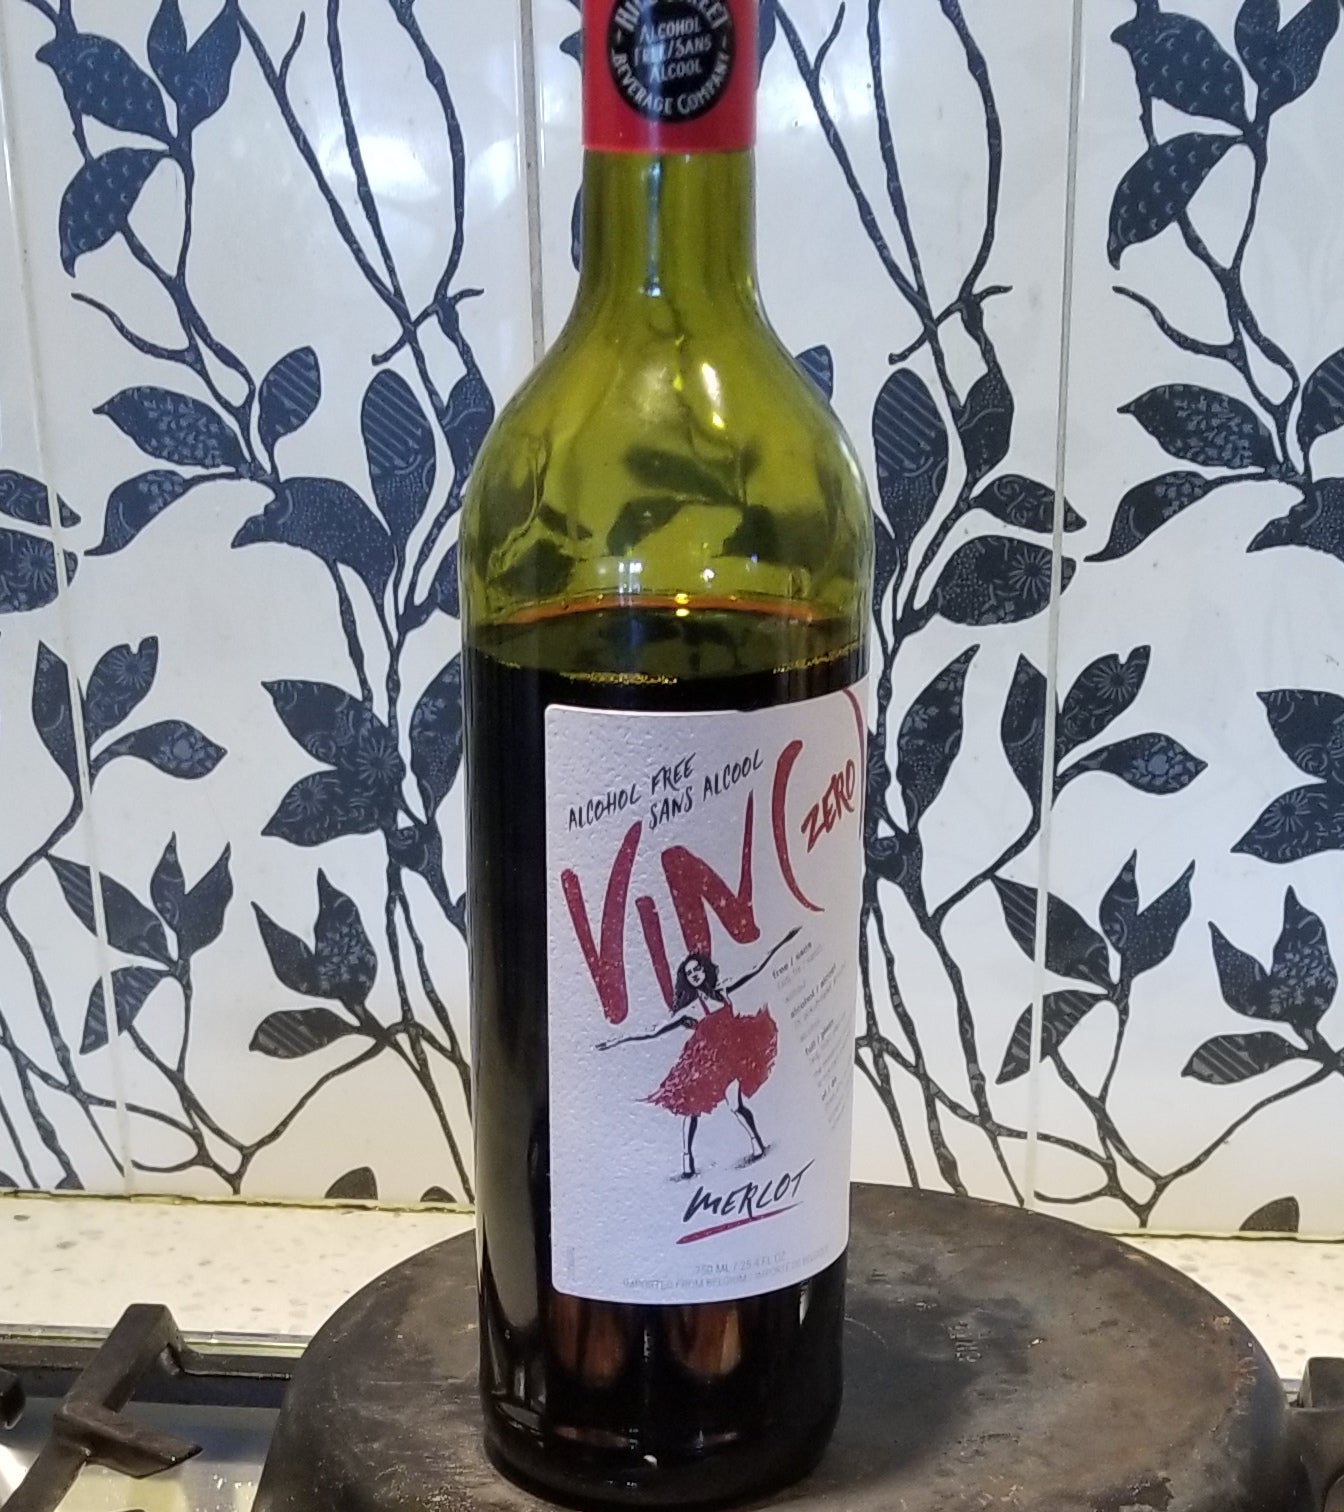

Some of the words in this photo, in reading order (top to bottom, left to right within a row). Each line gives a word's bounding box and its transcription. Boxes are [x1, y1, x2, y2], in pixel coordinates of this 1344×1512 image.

[639, 17, 701, 44] ALCOHOL
[611, 47, 674, 115] BEVERAGE
[677, 51, 730, 114] COMPANY
[649, 58, 702, 84] ALCOOL
[568, 783, 641, 832] ALCOHOL
[650, 752, 697, 796] FREE
[648, 787, 695, 830] SANS
[703, 749, 764, 802] ALCOOL
[682, 1159, 815, 1222] MERLOT
